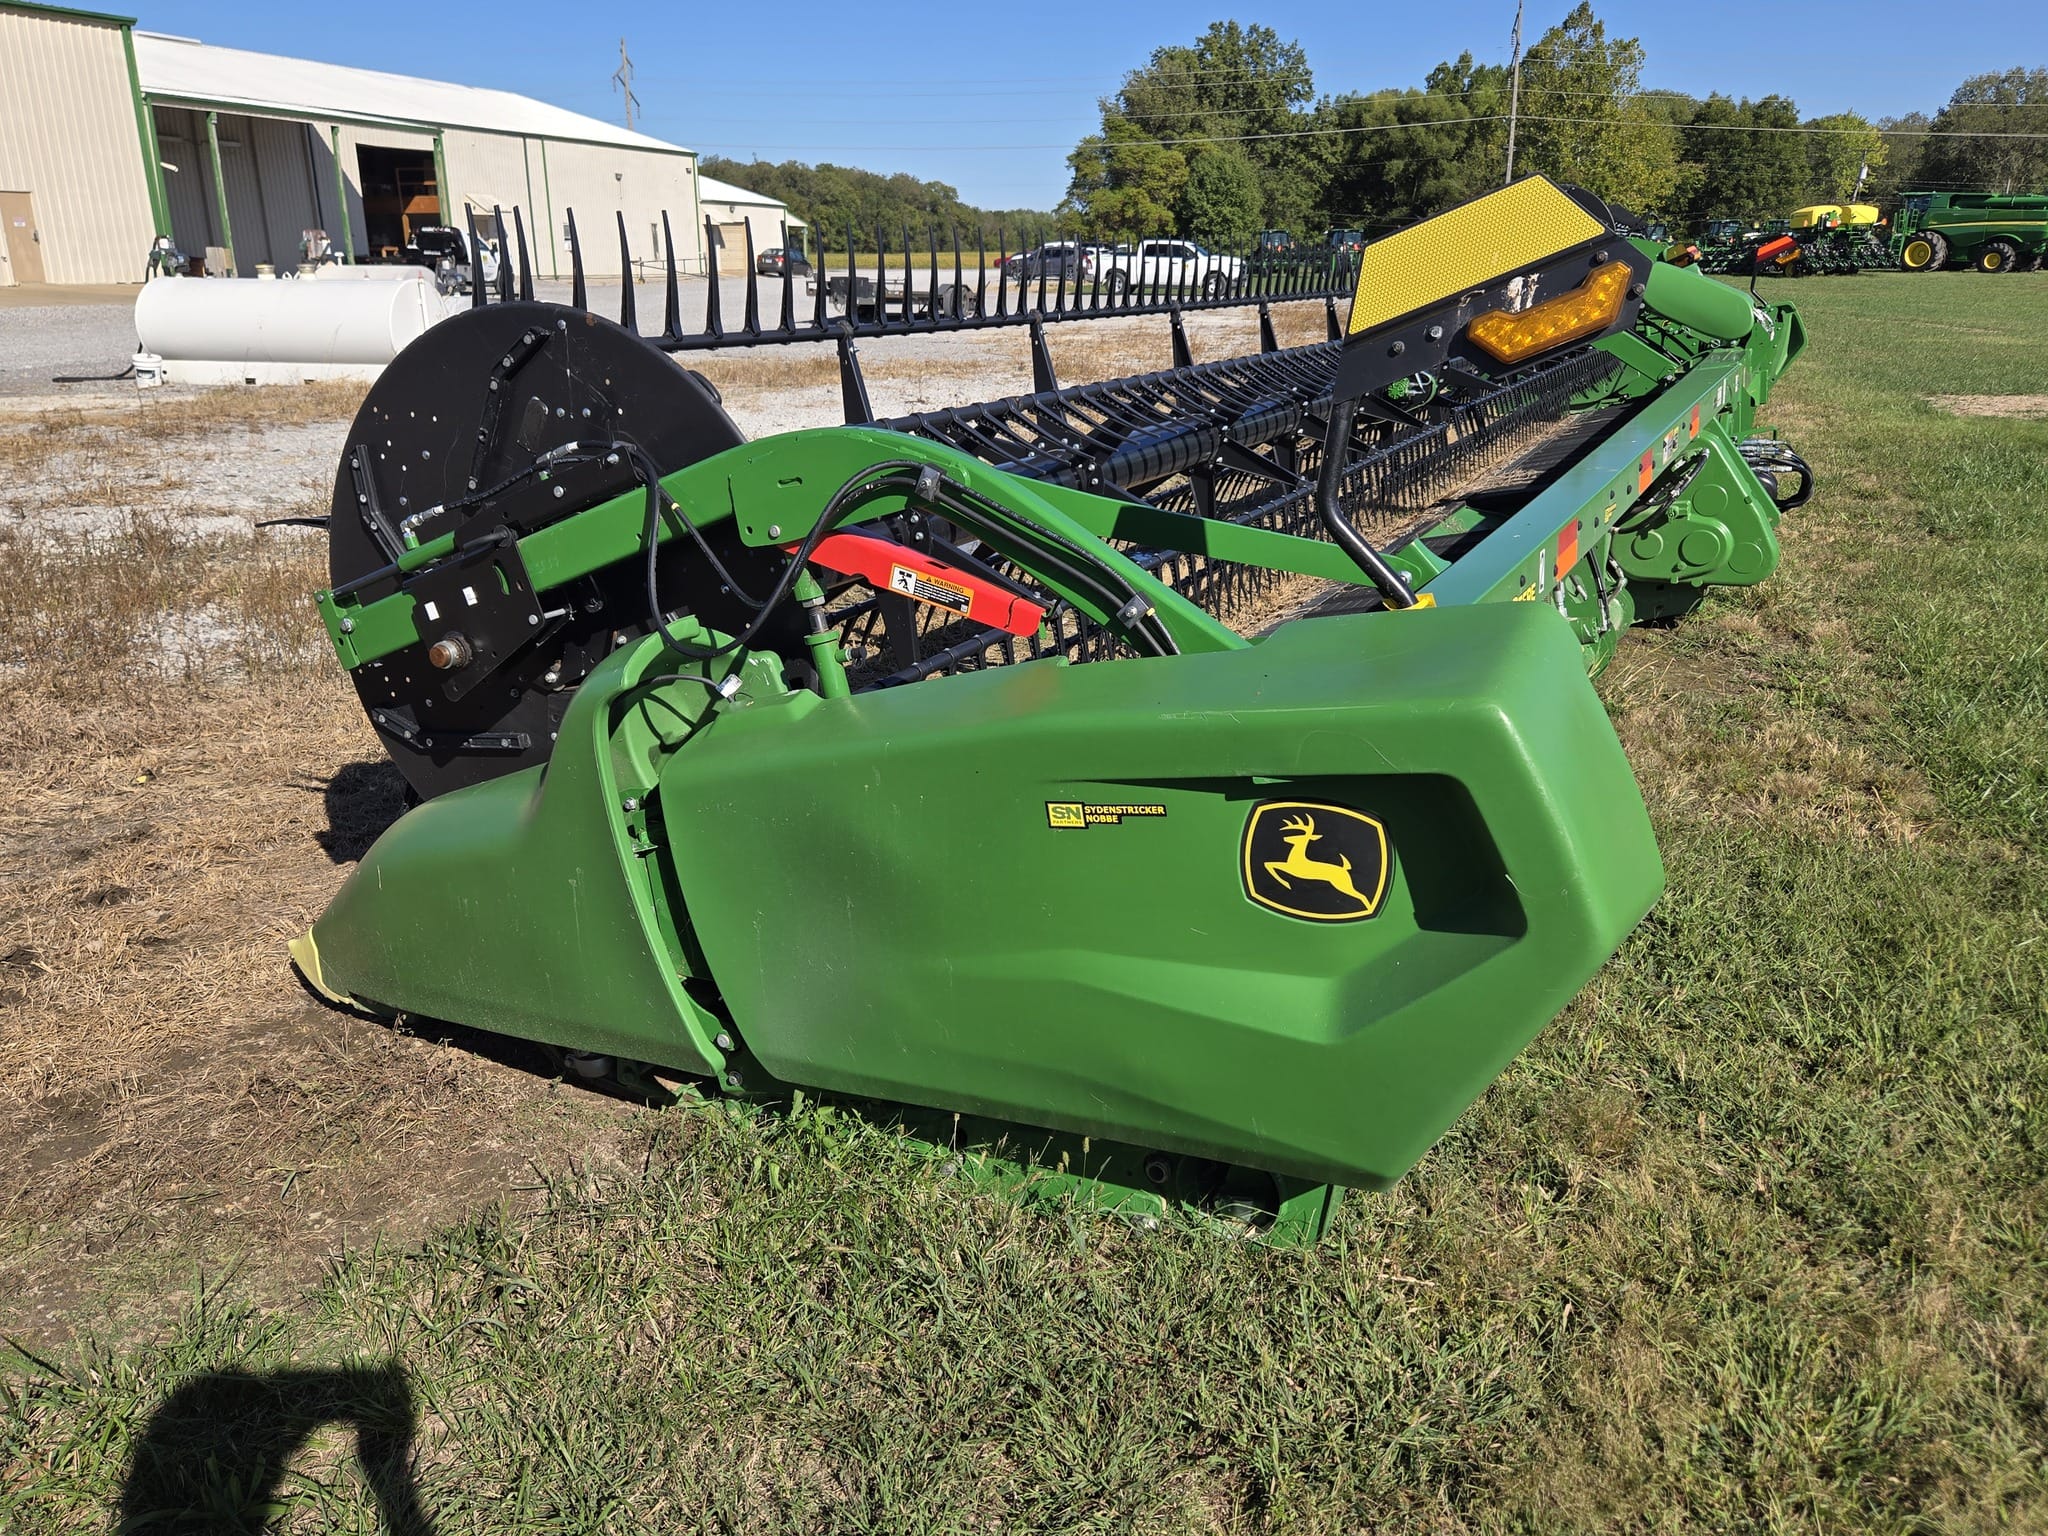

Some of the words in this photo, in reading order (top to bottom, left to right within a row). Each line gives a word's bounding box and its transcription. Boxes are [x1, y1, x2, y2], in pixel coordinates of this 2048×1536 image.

[934, 579, 964, 593] WARNING
[1051, 806, 1081, 820] SN
[1084, 806, 1165, 814] SYDENSTRICKER
[1086, 815, 1119, 823] NOBBE
